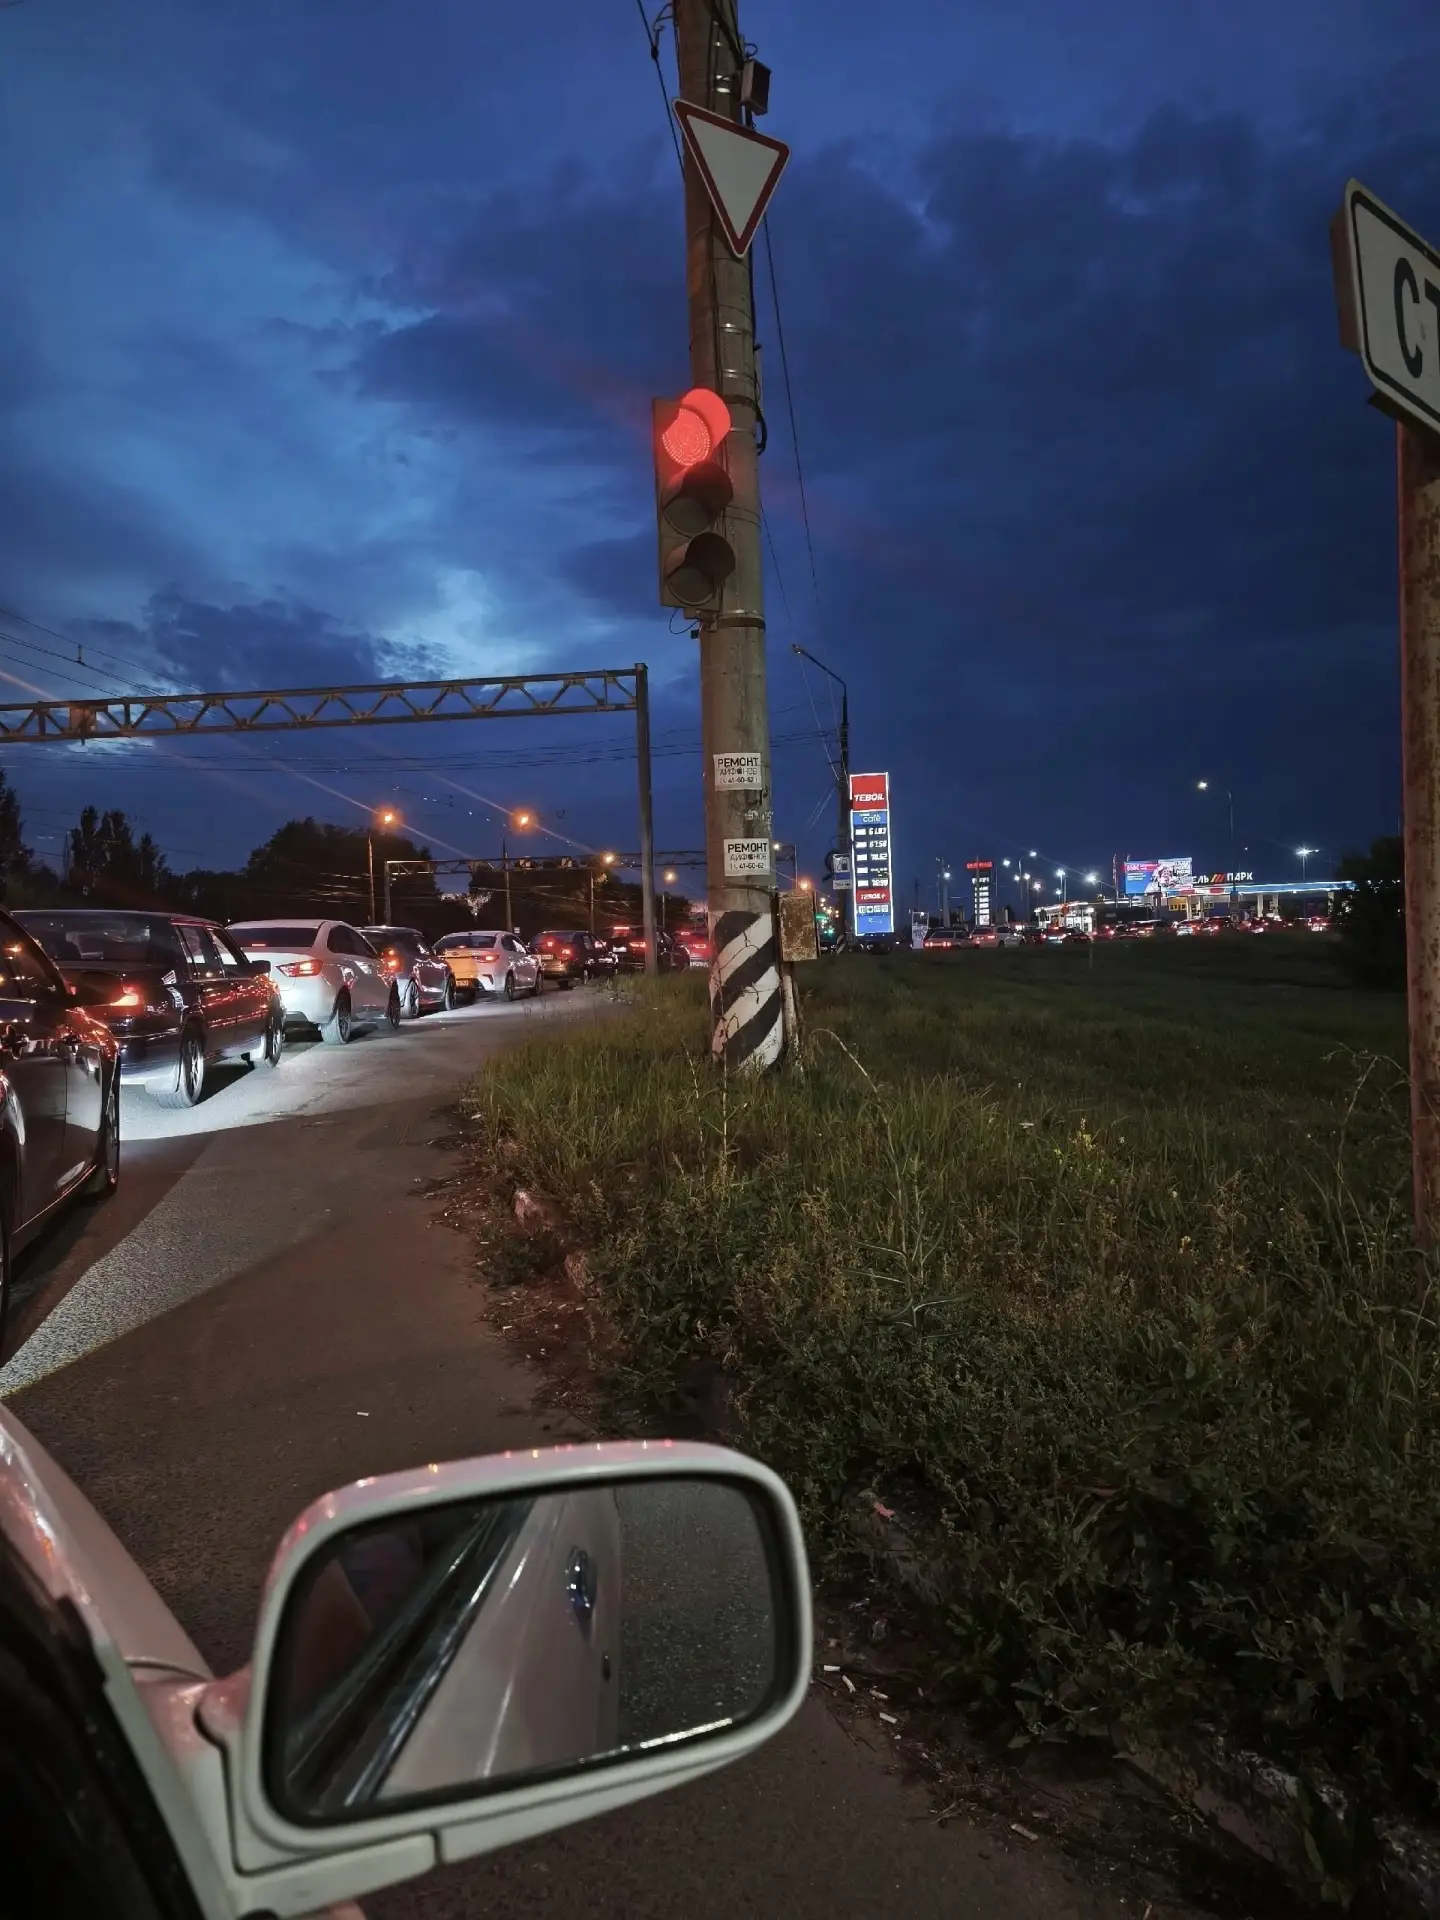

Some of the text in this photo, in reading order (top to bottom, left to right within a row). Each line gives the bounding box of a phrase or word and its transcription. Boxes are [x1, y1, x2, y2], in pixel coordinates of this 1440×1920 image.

[718, 757, 758, 768] РЕМОНТ
[853, 793, 885, 802] TEBOIL
[727, 843, 767, 854] РЕМОНТ
[1226, 872, 1253, 881] ПАРК
